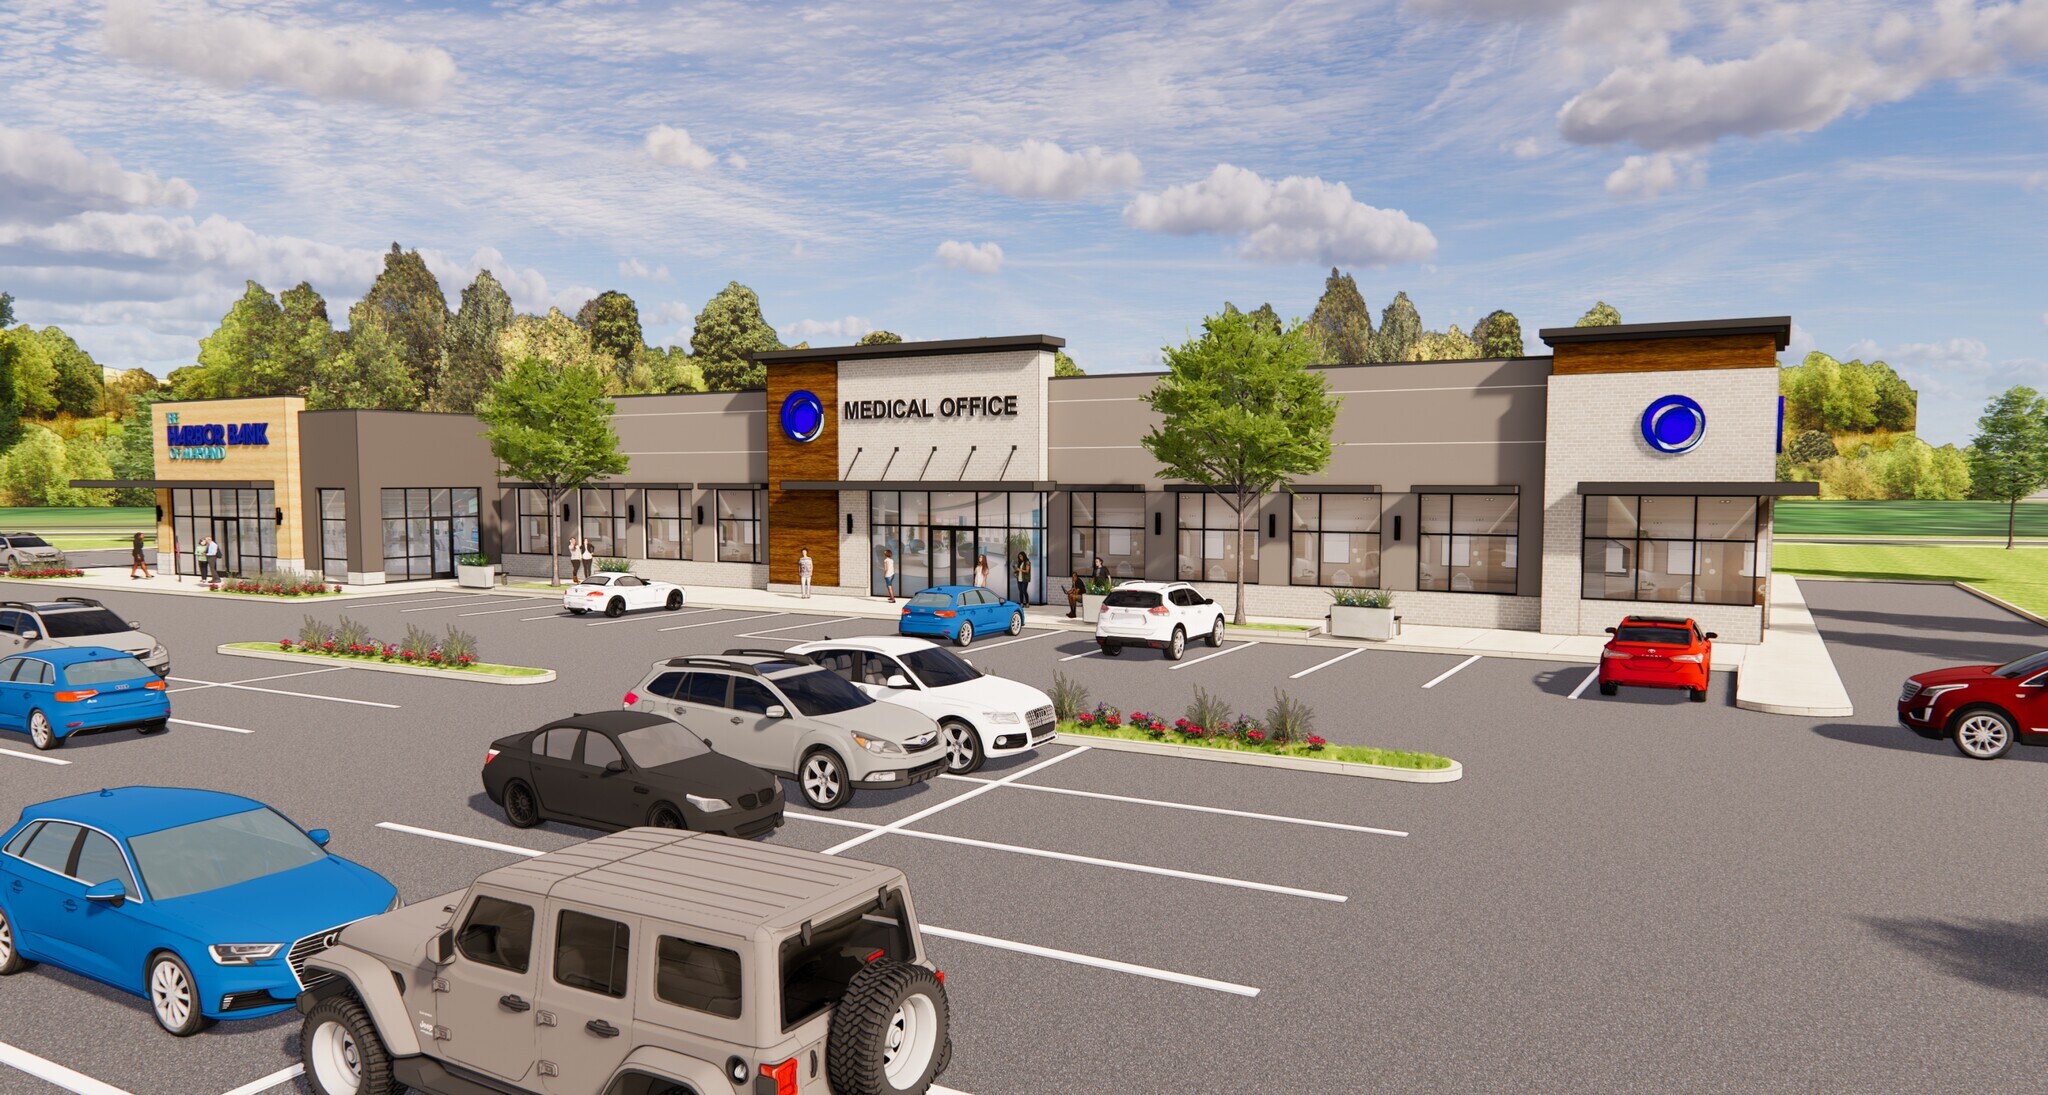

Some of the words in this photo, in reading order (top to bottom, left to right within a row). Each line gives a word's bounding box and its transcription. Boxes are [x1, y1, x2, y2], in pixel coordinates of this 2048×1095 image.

[844, 399, 934, 420] MEDICAL
[940, 395, 1018, 417] OFFICE
[167, 424, 226, 446] HARBOR
[228, 423, 269, 445] BANK
